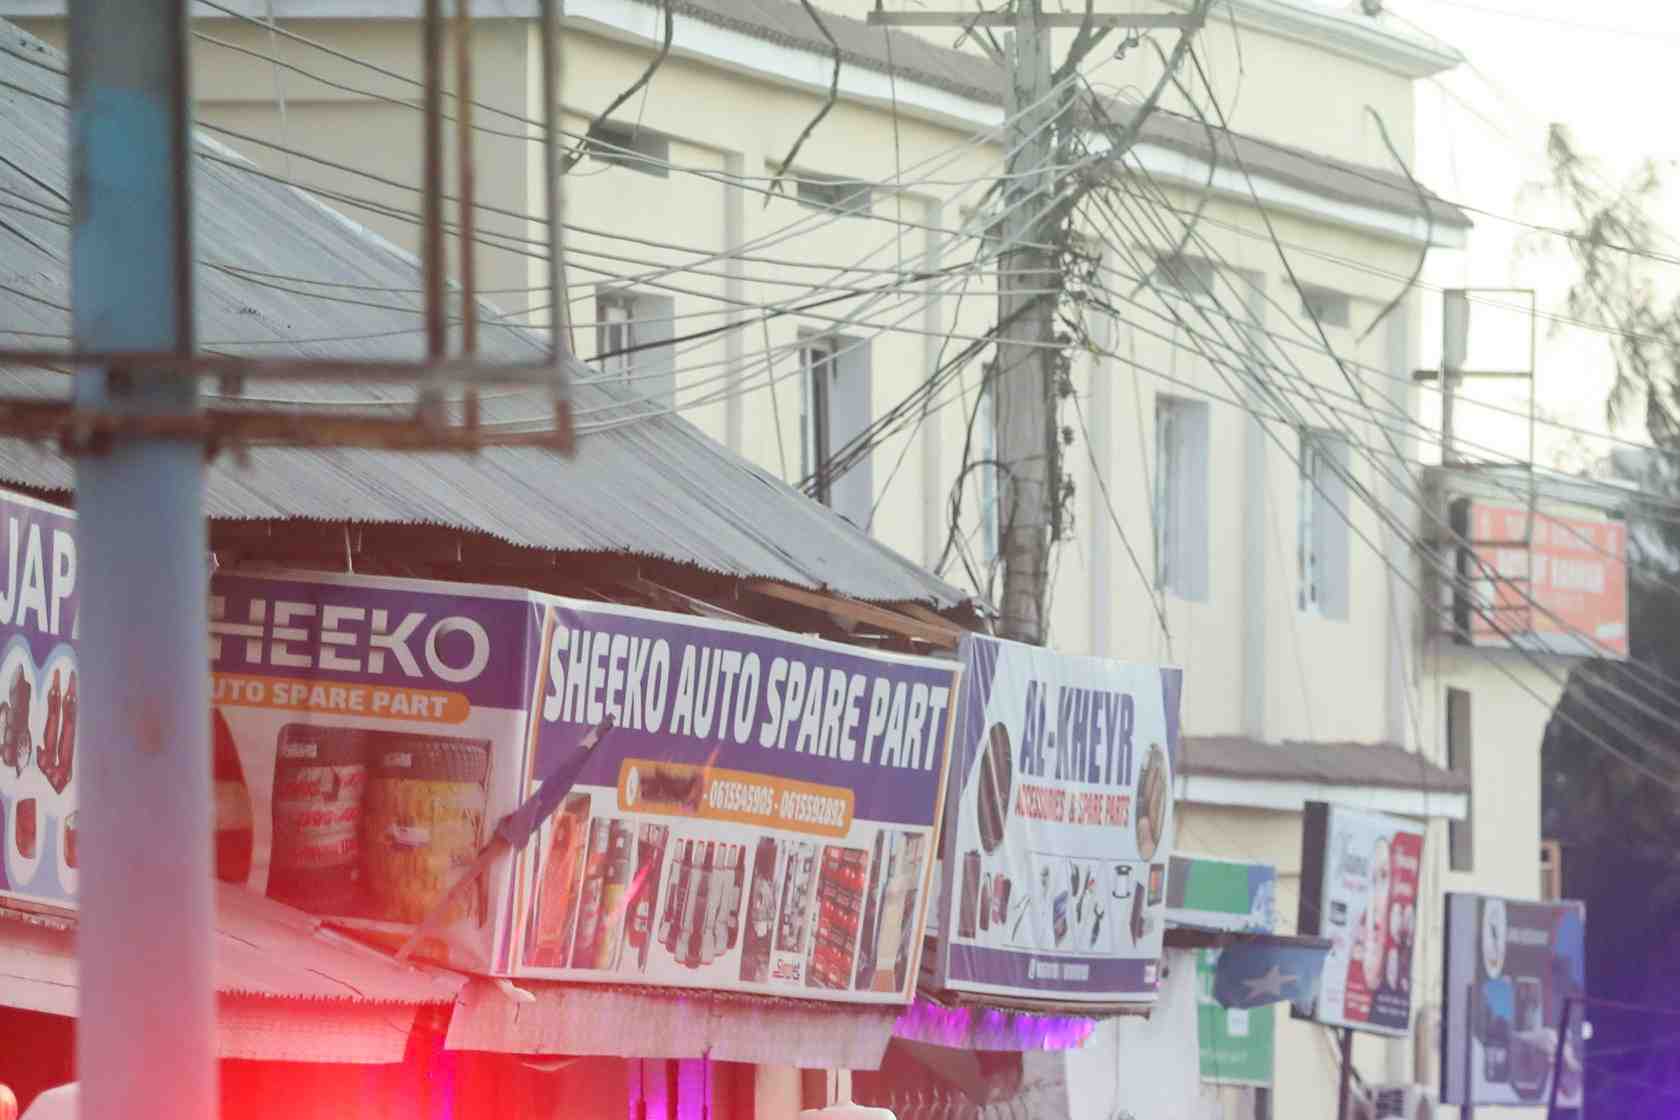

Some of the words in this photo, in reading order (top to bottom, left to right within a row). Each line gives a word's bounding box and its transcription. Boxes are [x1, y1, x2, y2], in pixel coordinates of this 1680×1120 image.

[0, 517, 80, 640] JAP
[207, 594, 490, 683] HEEKO
[211, 679, 265, 704] UTO
[272, 681, 366, 712] SPARE
[372, 691, 448, 717] PART
[543, 625, 671, 734] SHEEKO
[670, 644, 761, 744] AUTO
[761, 657, 866, 762] SPARE
[862, 677, 950, 770] PART
[1019, 680, 1135, 786] AL-KHEYR
